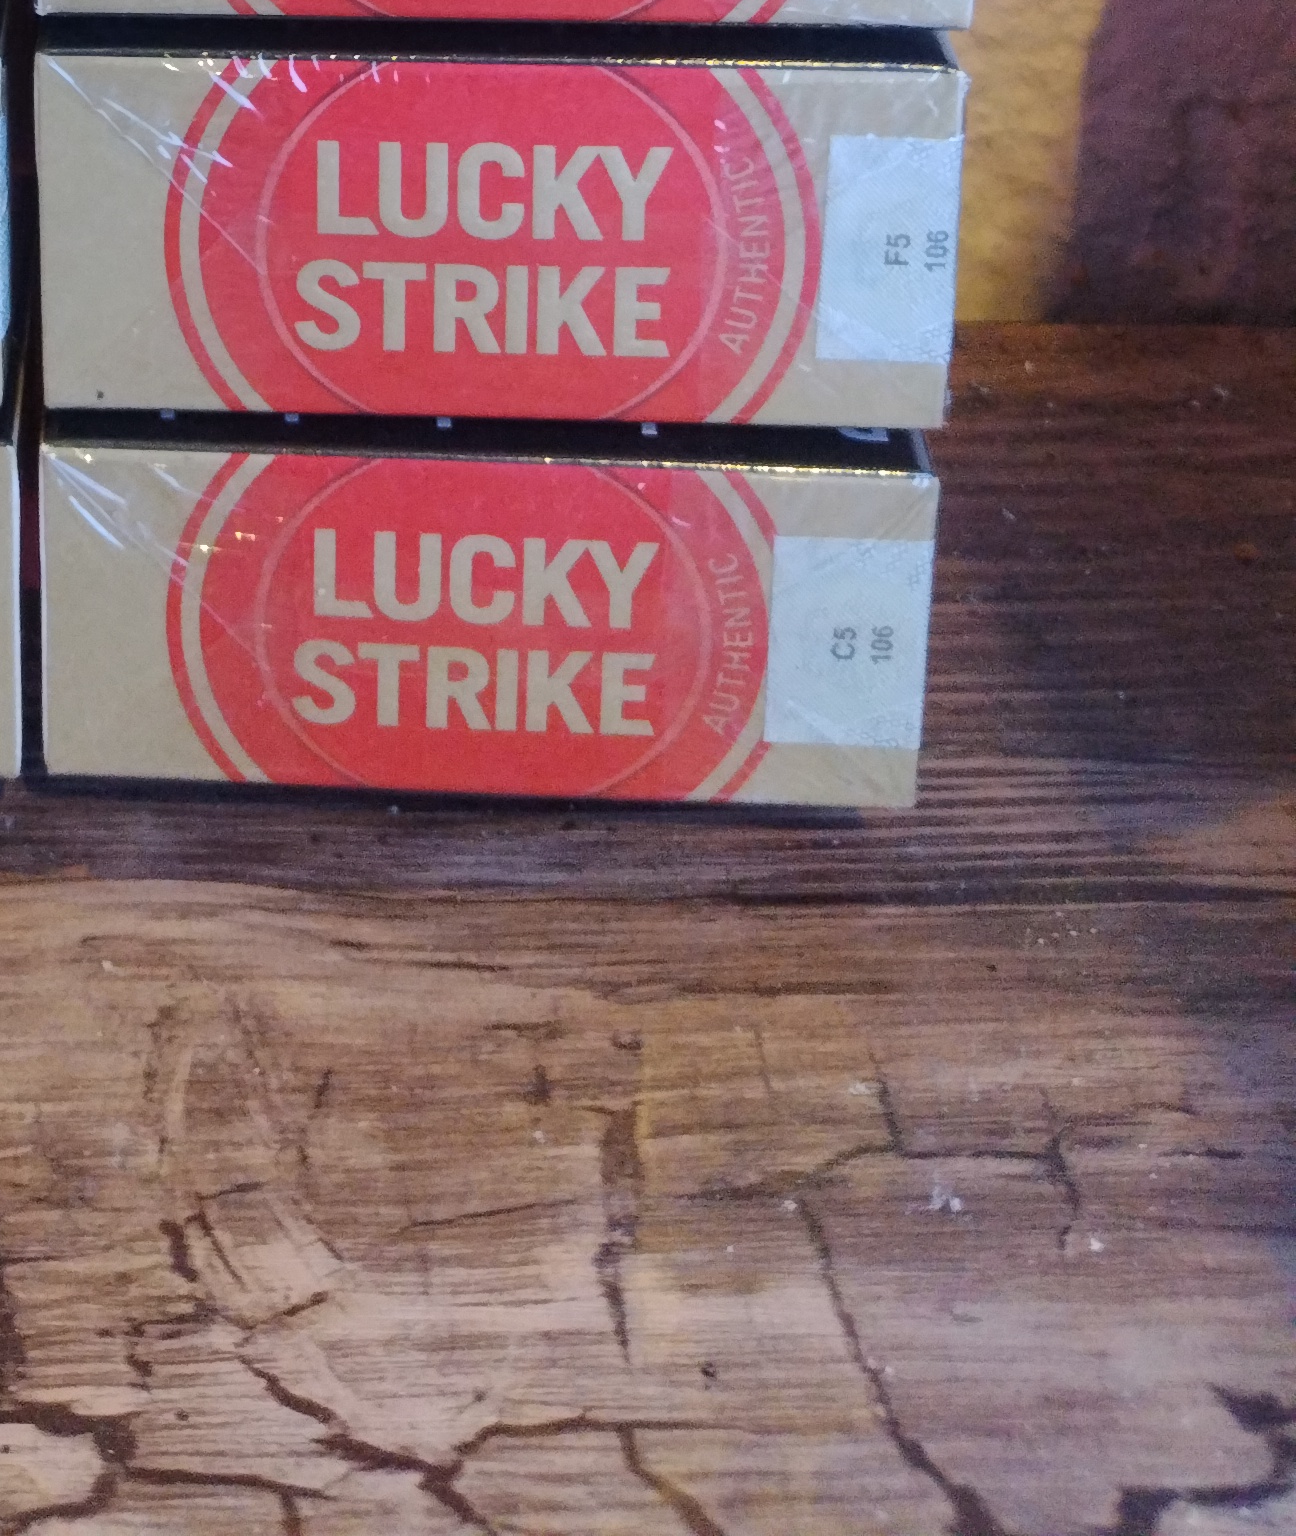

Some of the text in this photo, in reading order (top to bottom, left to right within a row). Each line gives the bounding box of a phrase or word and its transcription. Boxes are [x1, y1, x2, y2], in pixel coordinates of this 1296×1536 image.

[315, 139, 674, 242] LUCKY
[718, 156, 771, 355] AUTHENTIC
[884, 233, 911, 266] F5
[924, 229, 949, 272] 106
[294, 260, 671, 360] STRIKE
[312, 527, 661, 629] LUCKY
[291, 639, 656, 738] STRIKE
[704, 551, 754, 736] AUTHENTIC
[830, 627, 857, 661] C5
[870, 625, 894, 665] 106
